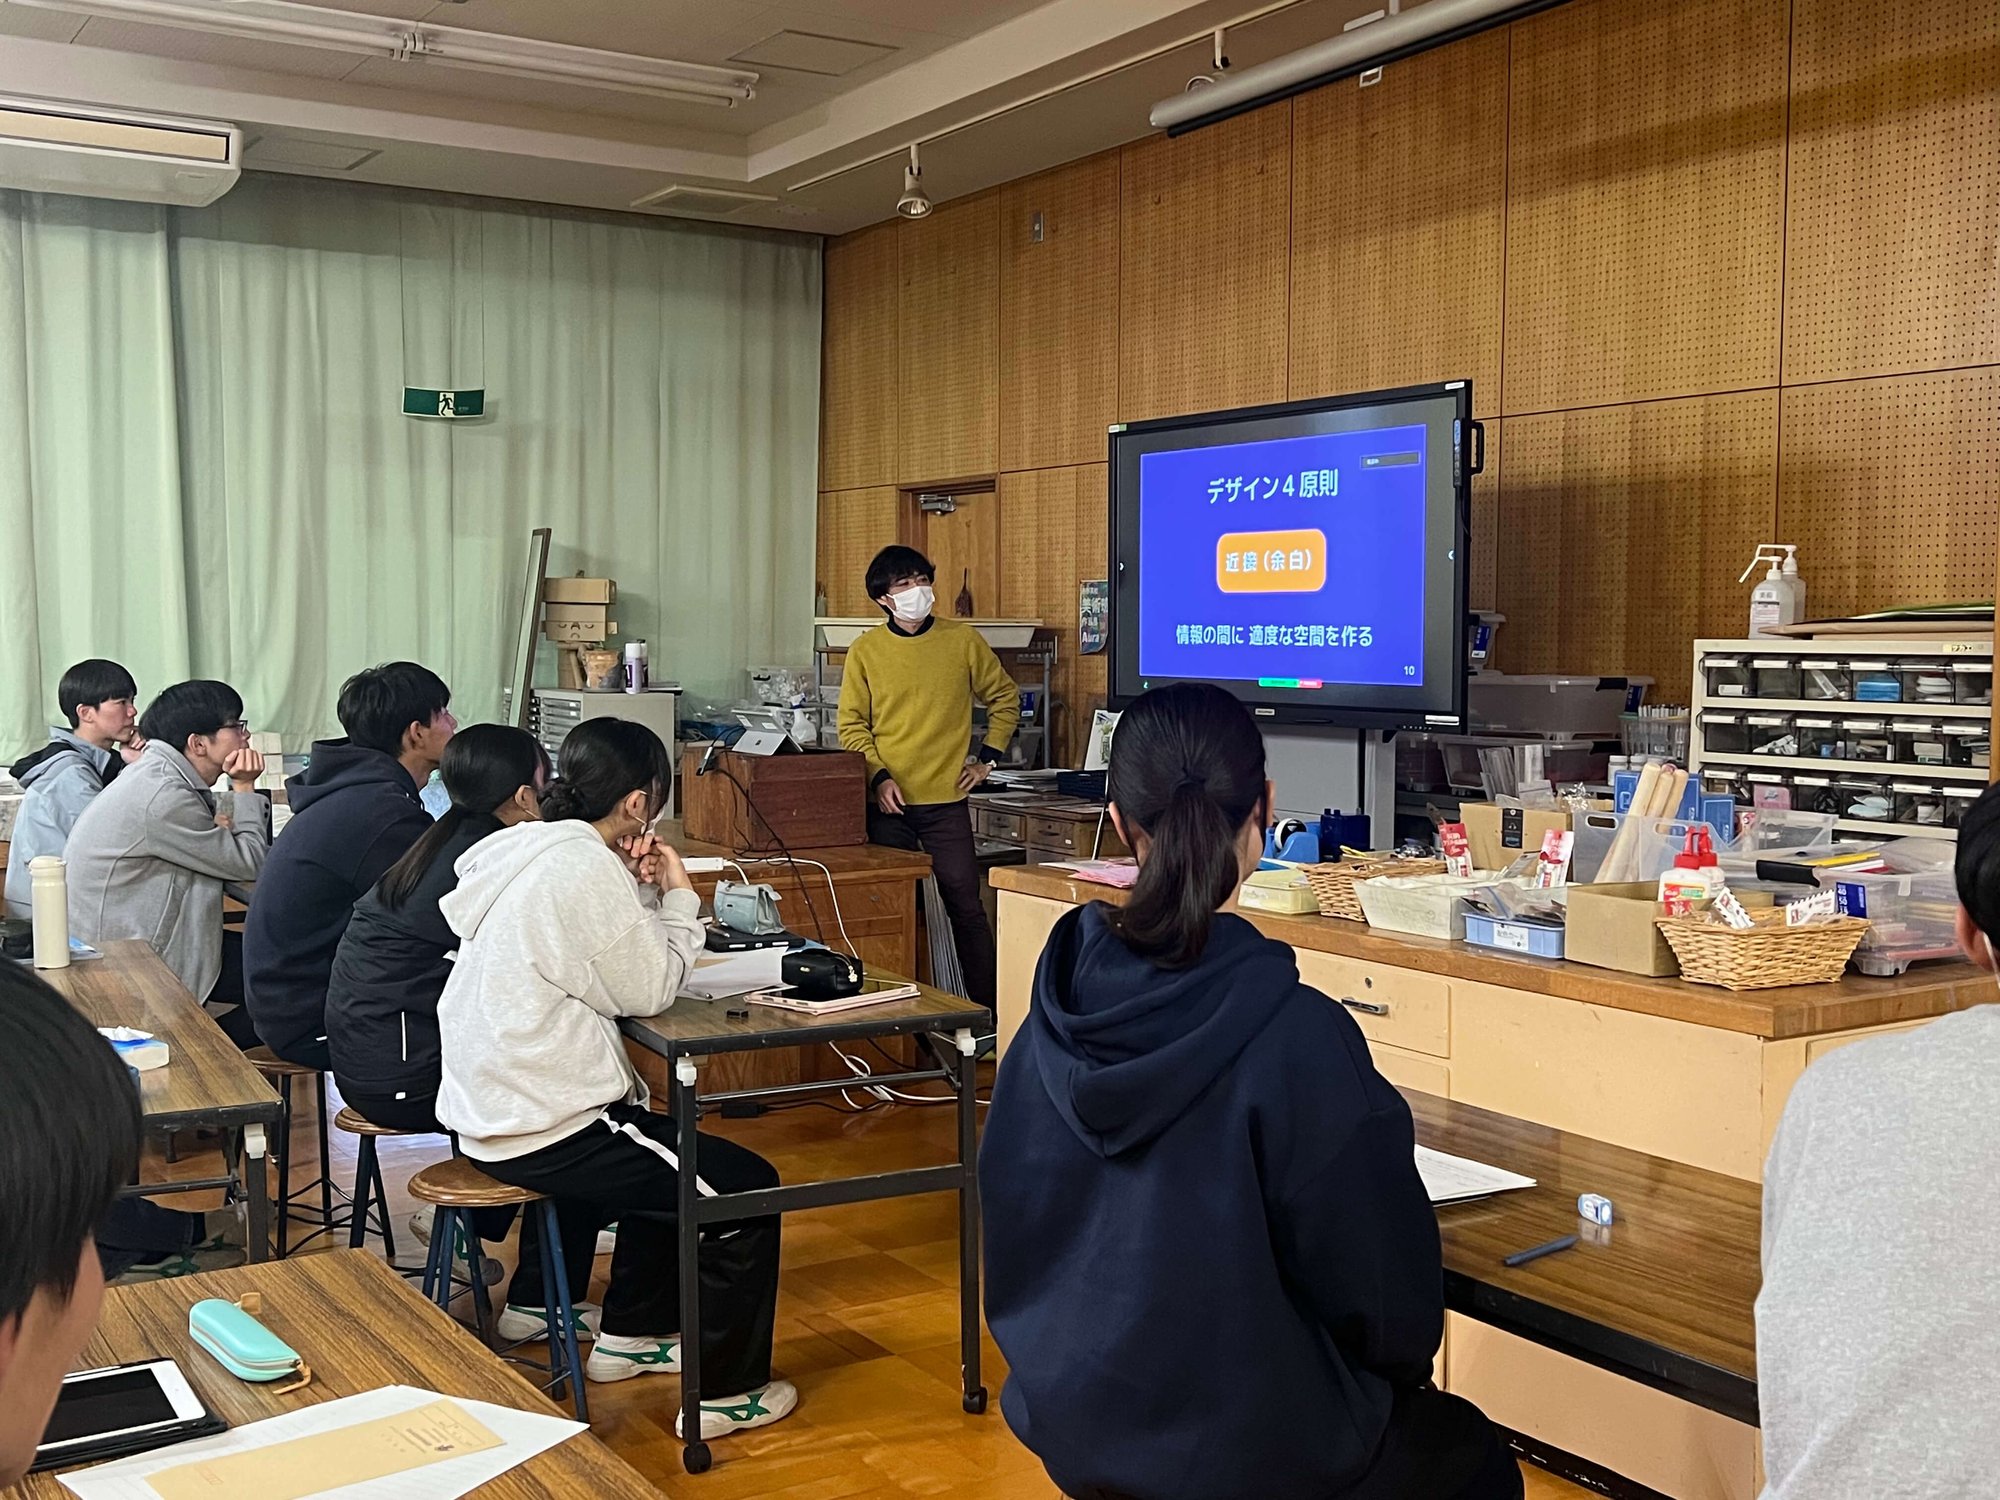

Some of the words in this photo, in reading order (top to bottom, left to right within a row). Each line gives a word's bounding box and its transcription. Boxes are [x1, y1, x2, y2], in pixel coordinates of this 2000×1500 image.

[1176, 624, 1244, 646] 情報の間に
[1249, 625, 1372, 647] 適度な空間を作る
[1403, 665, 1415, 676] 10
